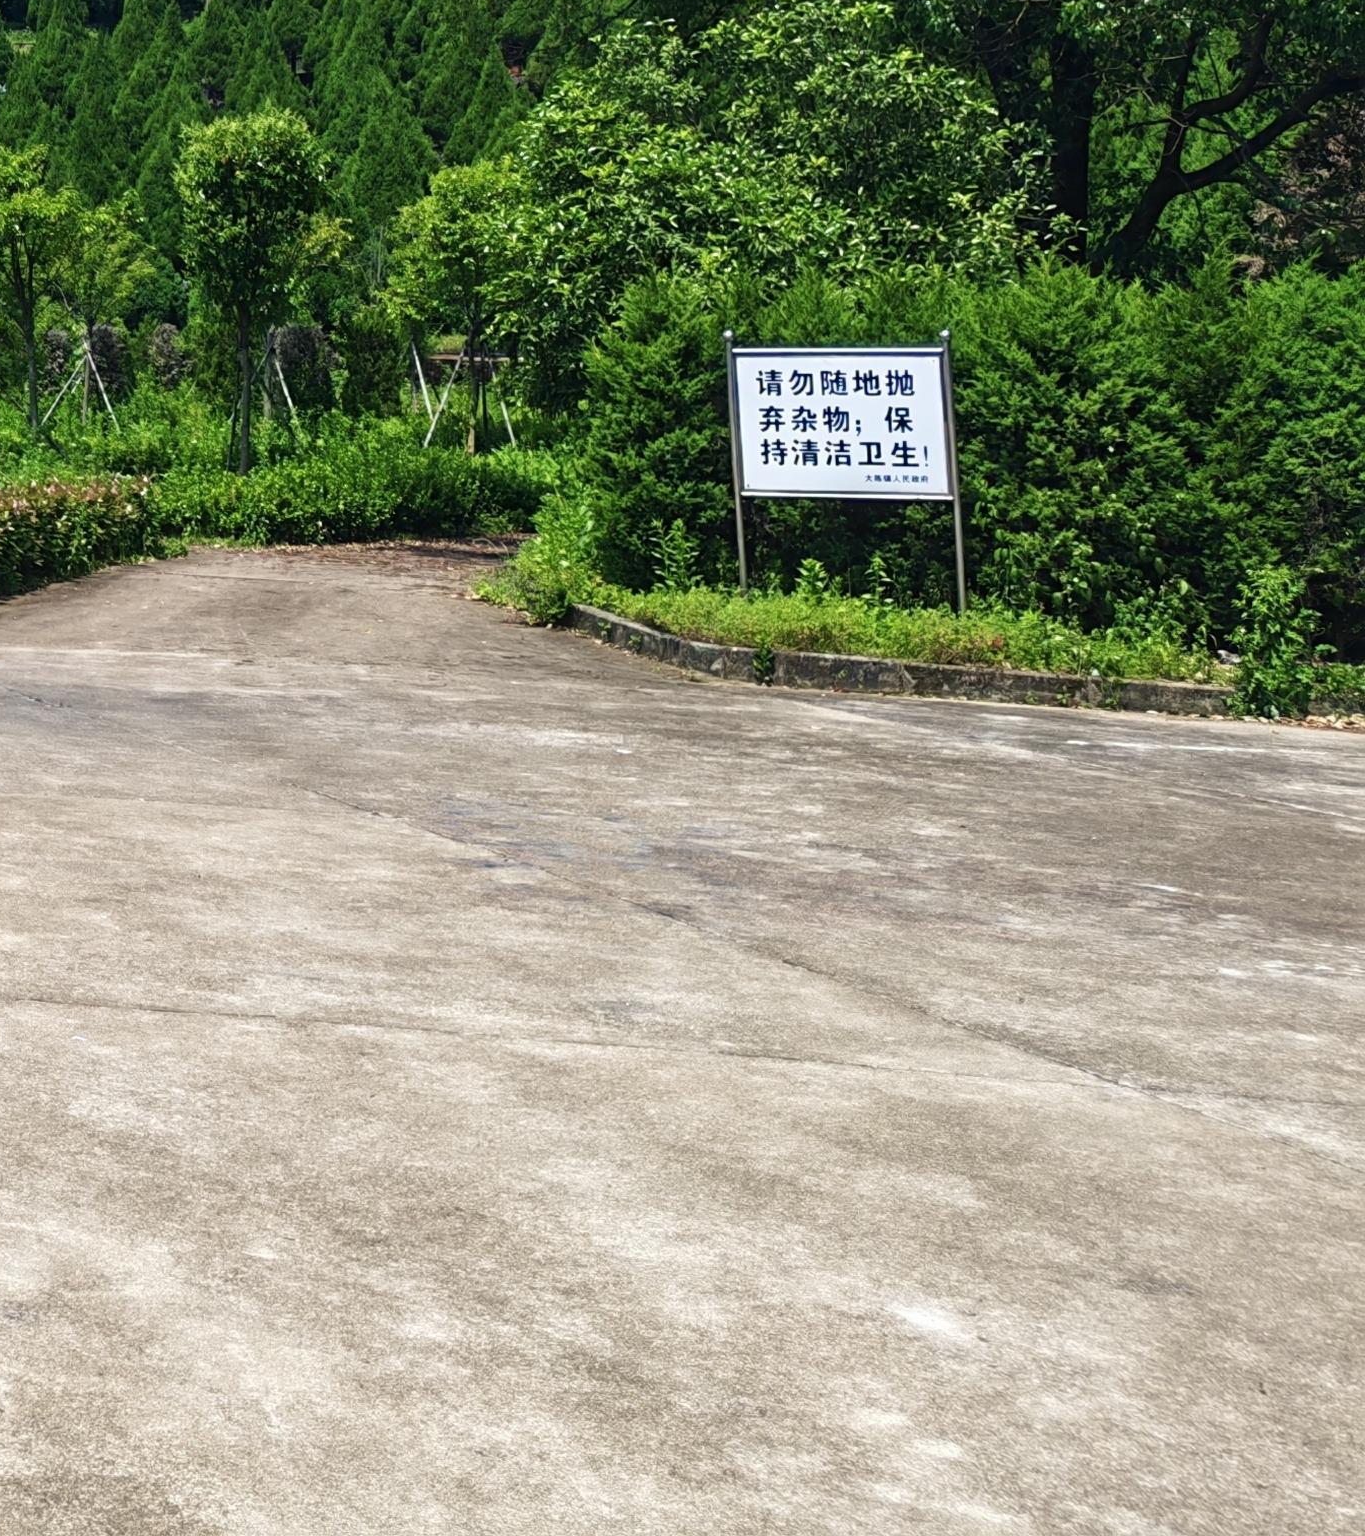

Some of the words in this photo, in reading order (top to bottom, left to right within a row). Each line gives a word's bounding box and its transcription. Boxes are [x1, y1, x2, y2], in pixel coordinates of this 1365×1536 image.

[755, 369, 916, 397] 请勿随地抛
[760, 439, 929, 468] 持清洁卫生！
